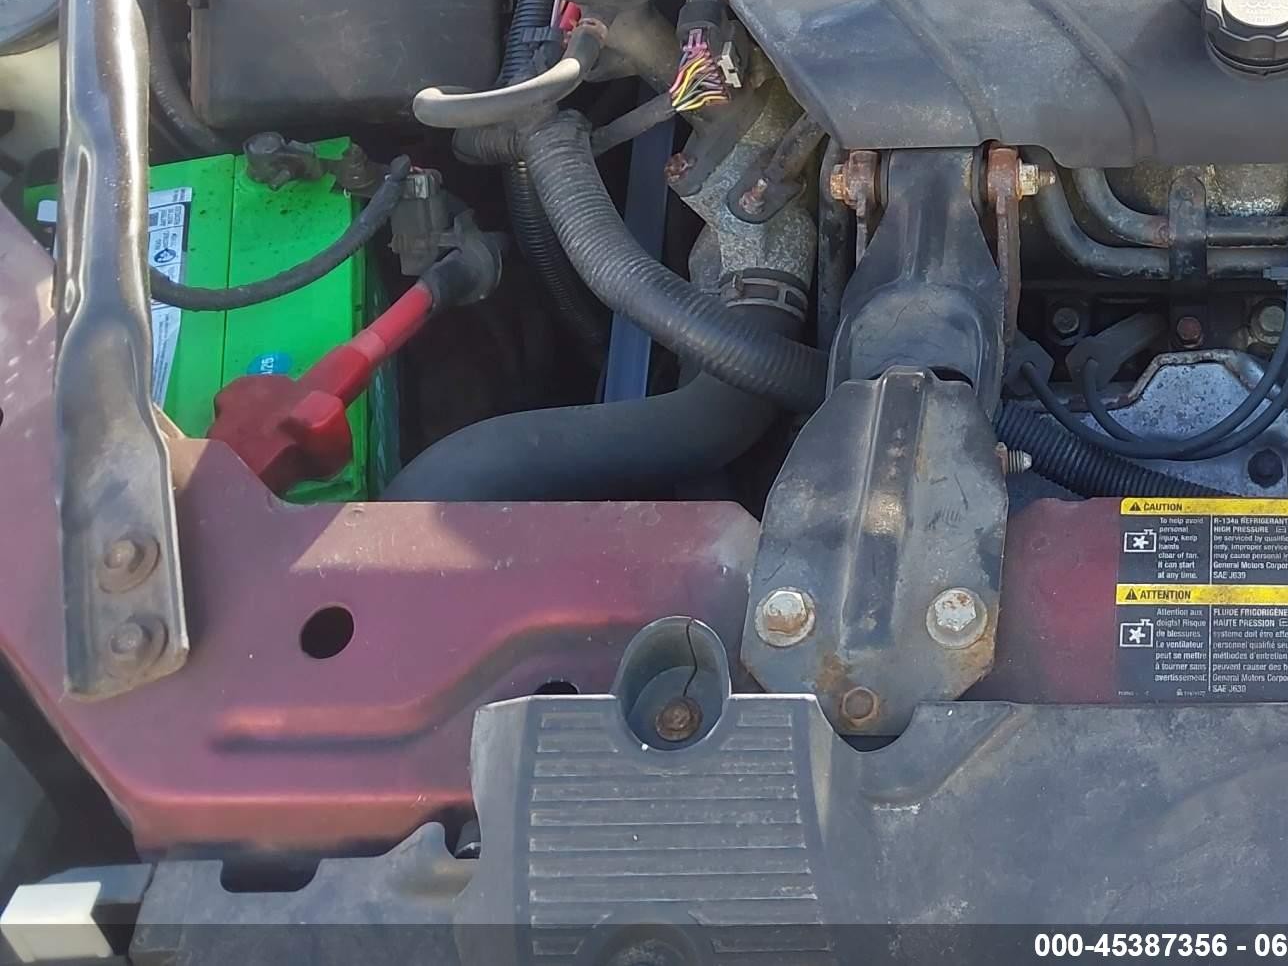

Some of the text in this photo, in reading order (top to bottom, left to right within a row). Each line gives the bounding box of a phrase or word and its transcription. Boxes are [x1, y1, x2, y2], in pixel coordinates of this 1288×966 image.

[1144, 503, 1182, 511] CAUTION
[1140, 590, 1191, 600] ATTENTION
[1213, 619, 1237, 627] HAUTE
[1239, 619, 1275, 627] PRESSION
